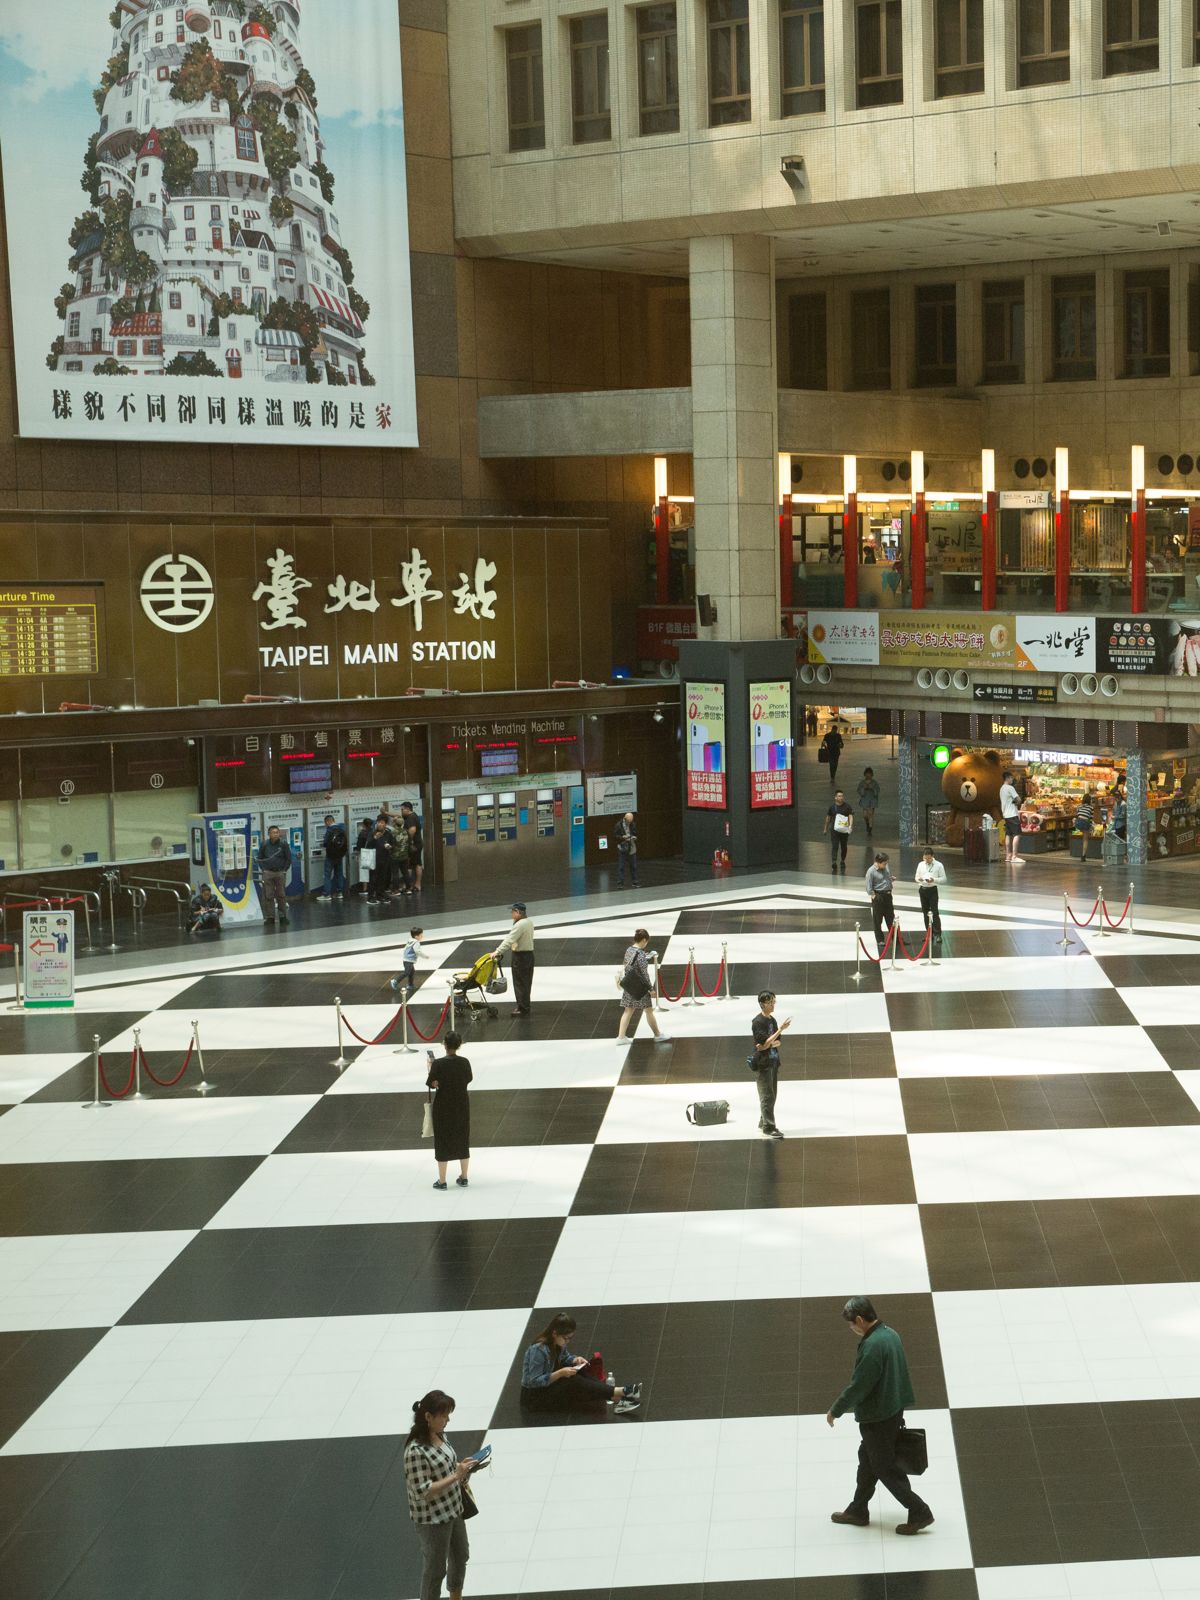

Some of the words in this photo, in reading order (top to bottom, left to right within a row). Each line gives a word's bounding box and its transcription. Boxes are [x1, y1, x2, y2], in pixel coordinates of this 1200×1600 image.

[52, 389, 392, 430] 樣貌不同卻同樣溫暖的是家
[30, 592, 56, 602] Time
[252, 548, 497, 632] 臺北車站
[881, 629, 985, 651] 最好吃的太陽餅
[259, 645, 329, 668] TAIPEI
[344, 643, 398, 665] MAIN
[412, 640, 496, 662] STATION
[811, 653, 819, 661] 1F
[452, 725, 487, 738] Tickets
[491, 723, 526, 736] Vending
[531, 720, 565, 733] Machine
[992, 722, 1026, 735] Breeze
[245, 727, 395, 752] 自動售票機
[1014, 748, 1041, 762] LINE
[1042, 750, 1094, 765] FRIENDS
[30, 916, 47, 925] 購票
[30, 925, 47, 934] 入口
